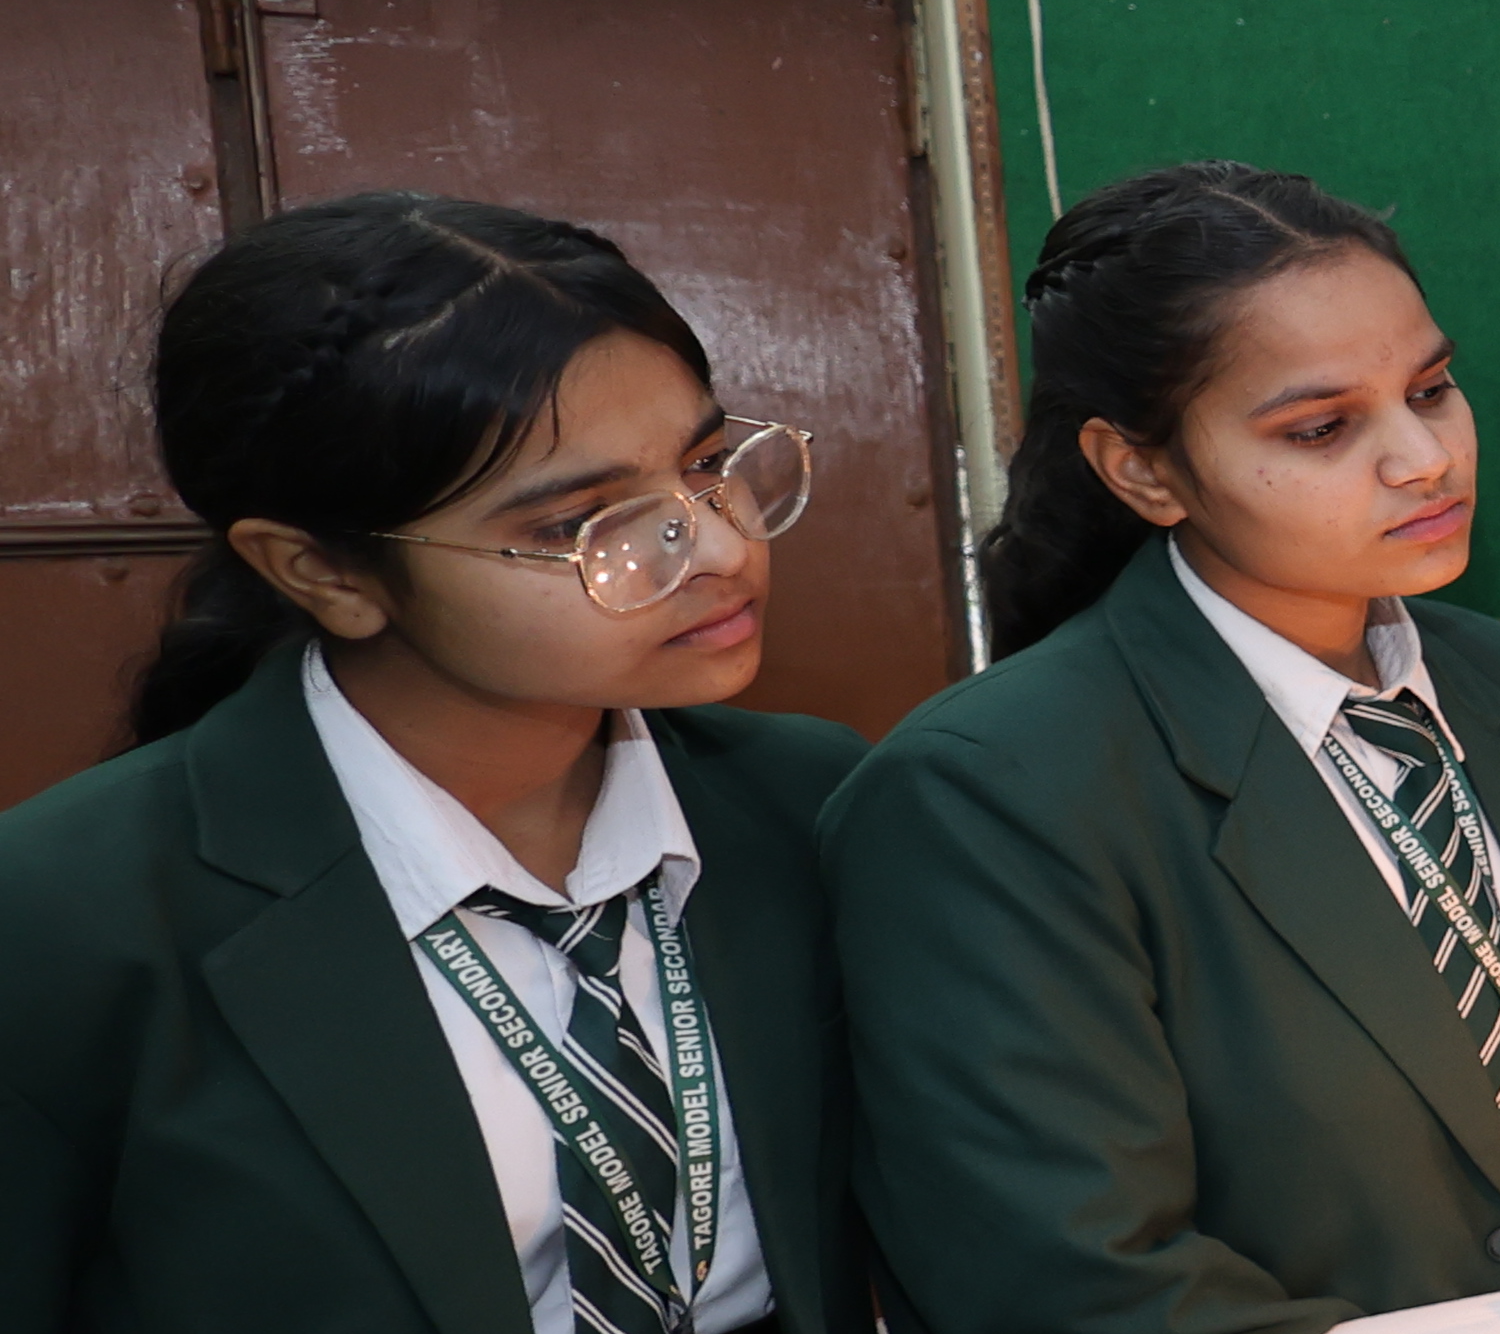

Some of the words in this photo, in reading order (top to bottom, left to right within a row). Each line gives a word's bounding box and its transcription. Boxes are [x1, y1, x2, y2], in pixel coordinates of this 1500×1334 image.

[1389, 824, 1446, 890] SENIOR
[646, 879, 693, 996] SECONDAR
[1436, 885, 1484, 946] MODEL
[425, 928, 535, 1050] SECONDARY
[674, 997, 706, 1079] SENIOR
[520, 1041, 591, 1126] SENIOR
[684, 1081, 713, 1160] MODEL
[574, 1119, 636, 1194] MODEL
[616, 1191, 664, 1276] TAGORE
[689, 1161, 714, 1251] TAGORE
